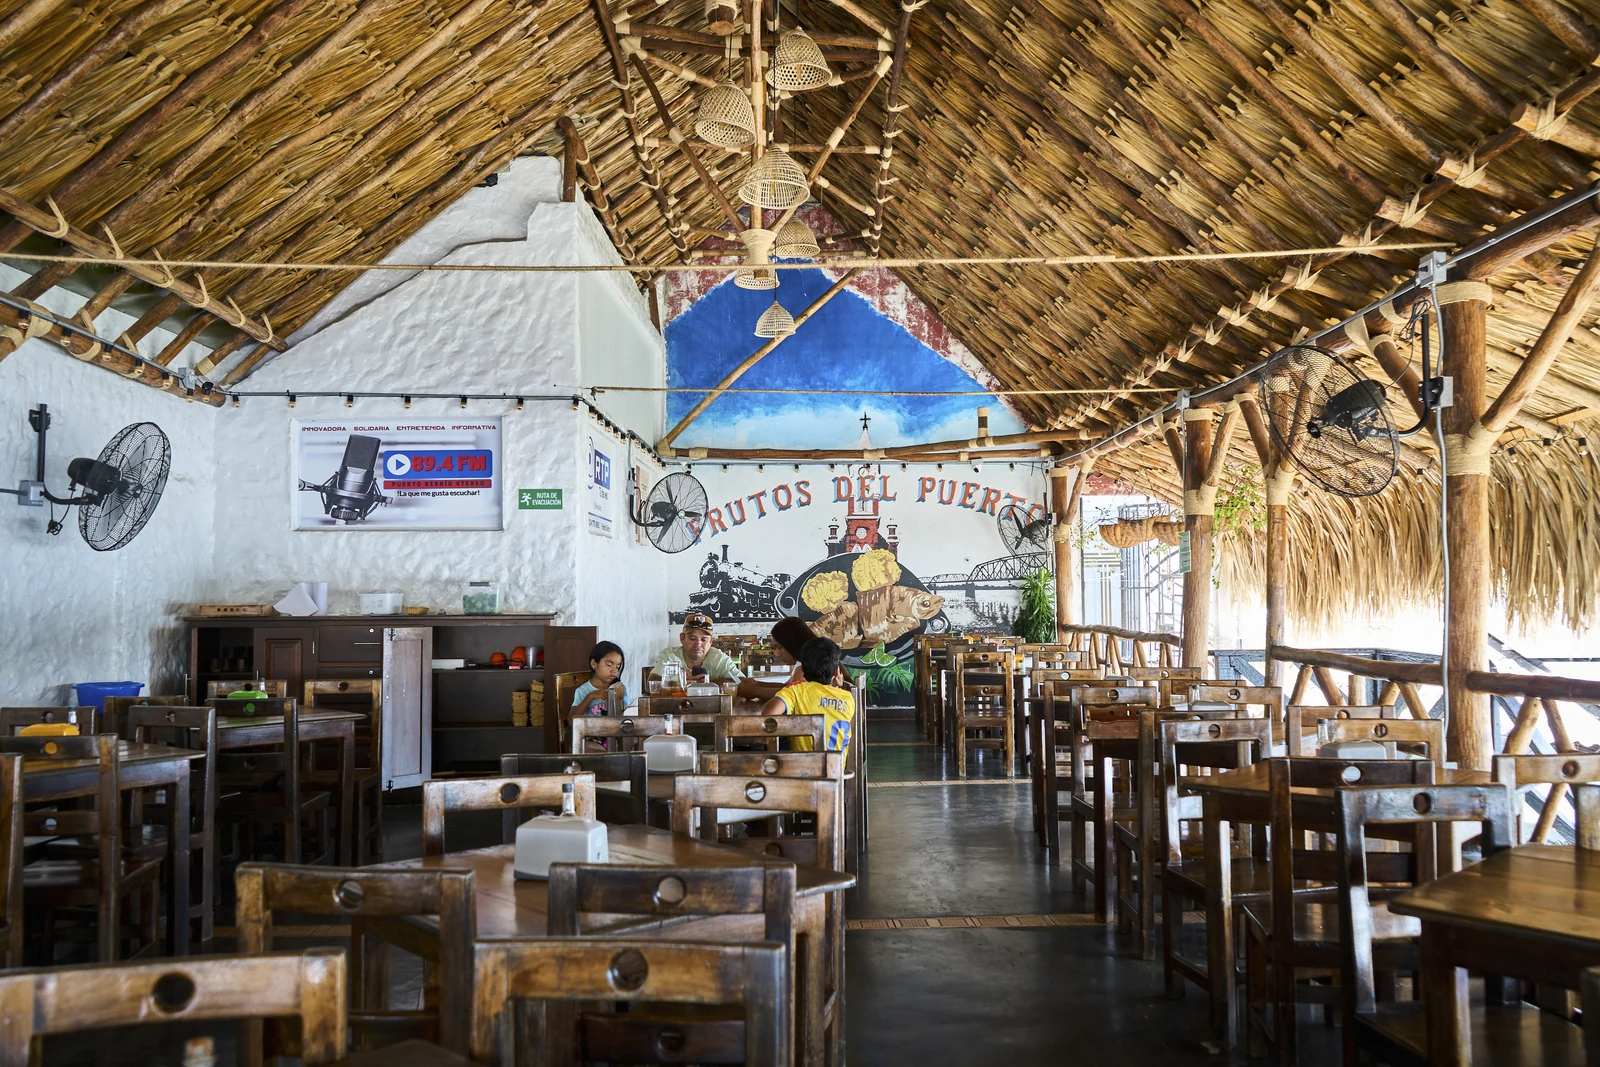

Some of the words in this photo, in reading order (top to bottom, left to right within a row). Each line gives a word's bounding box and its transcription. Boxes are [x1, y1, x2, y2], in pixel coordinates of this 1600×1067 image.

[411, 455, 454, 472] 89.4
[457, 455, 487, 471] FM
[595, 455, 609, 484] RTP
[432, 490, 449, 498] gusta
[686, 480, 811, 546] FRUTOS
[831, 474, 897, 503] DEL
[916, 476, 1047, 526] PUERTO
[819, 697, 847, 711] JAMES
